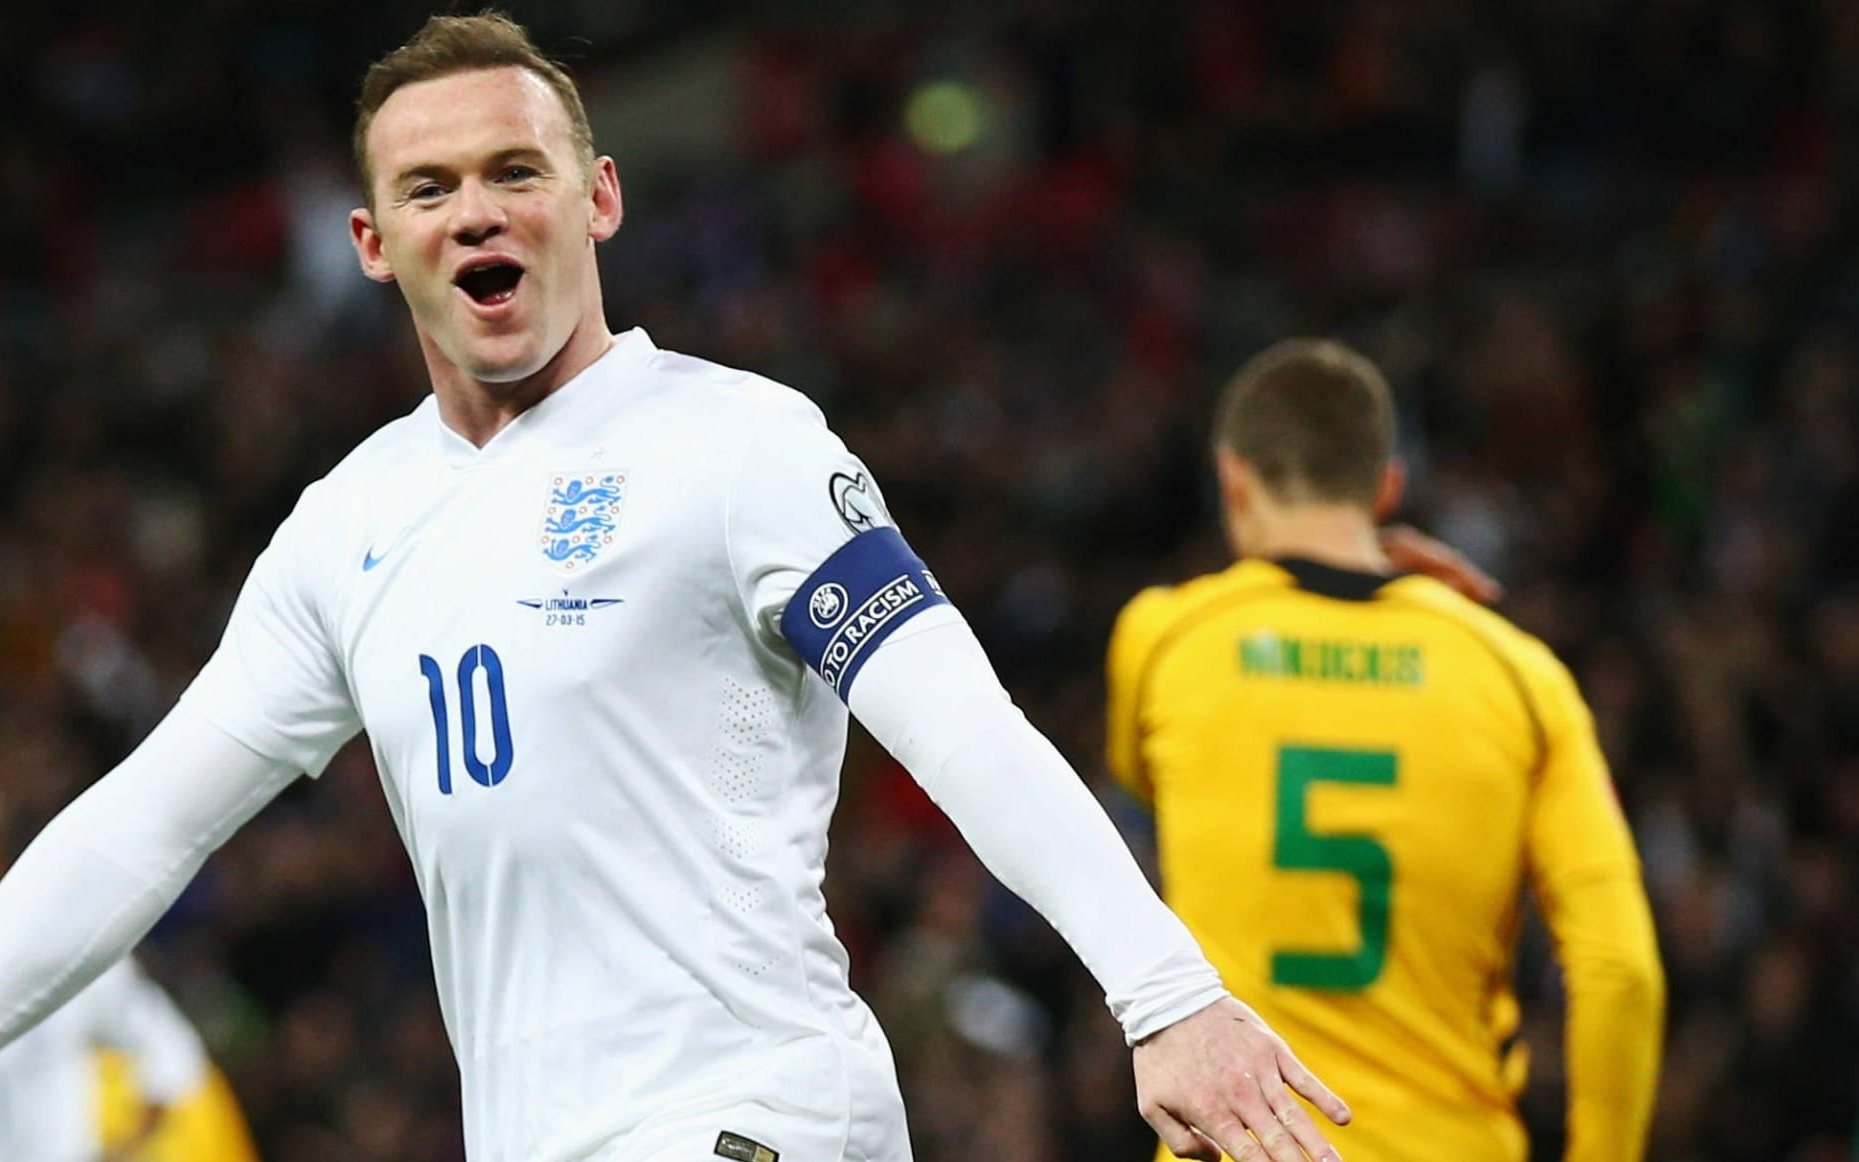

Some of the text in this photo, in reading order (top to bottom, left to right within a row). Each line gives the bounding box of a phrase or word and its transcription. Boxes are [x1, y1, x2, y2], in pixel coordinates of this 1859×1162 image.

[545, 599, 588, 611] LITHUANIA
[827, 642, 848, 670] TO
[845, 581, 919, 643] RACISM
[419, 644, 513, 794] 10
[1270, 744, 1399, 991] 5
